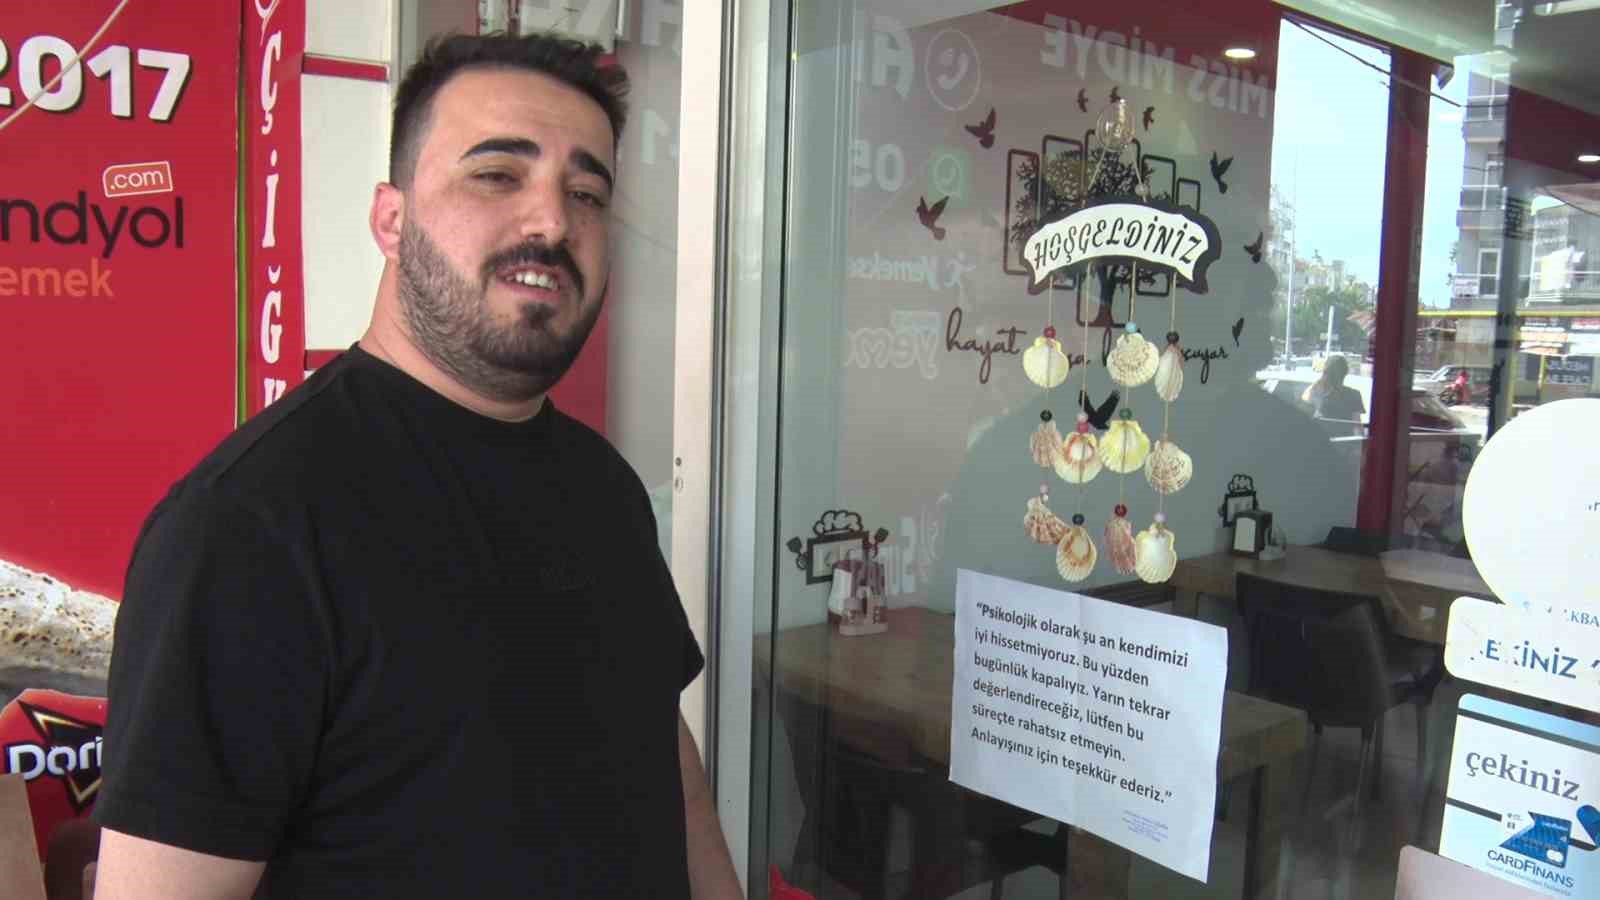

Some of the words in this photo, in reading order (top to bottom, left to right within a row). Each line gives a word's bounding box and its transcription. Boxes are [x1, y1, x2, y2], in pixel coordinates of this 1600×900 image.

[0, 35, 191, 121] 017
[110, 170, 164, 190] .com
[1034, 215, 1202, 270] HOŞGELDİNİZ
[946, 307, 1027, 384] hayat
[975, 627, 988, 644] iyi
[991, 631, 1080, 667] hissetmiyoruz.
[1083, 655, 1098, 672] Bu
[1101, 662, 1149, 686] yüzden
[1040, 618, 1080, 639] olarak
[1083, 631, 1096, 645] şu
[1099, 636, 1115, 649] an
[1119, 637, 1188, 667] kendimizi
[1470, 639, 1578, 680] EİNİZ
[973, 677, 1083, 723] değerlendireceğiz,
[1086, 709, 1123, 735] lütfen
[1127, 722, 1144, 742] bu
[974, 652, 1028, 679] bugünlük
[1031, 667, 1089, 696] kapalıyız.
[1092, 685, 1125, 708] Yarın
[1129, 697, 1171, 720] tekrar
[970, 726, 1034, 758] Anlayışınız
[1036, 746, 1059, 766] için
[1062, 755, 1117, 786] teşekkür
[972, 703, 1016, 726] süreçte
[1018, 718, 1067, 743] rahatsız
[1070, 734, 1126, 763] etmeyin.
[1466, 752, 1580, 801] çekiniz
